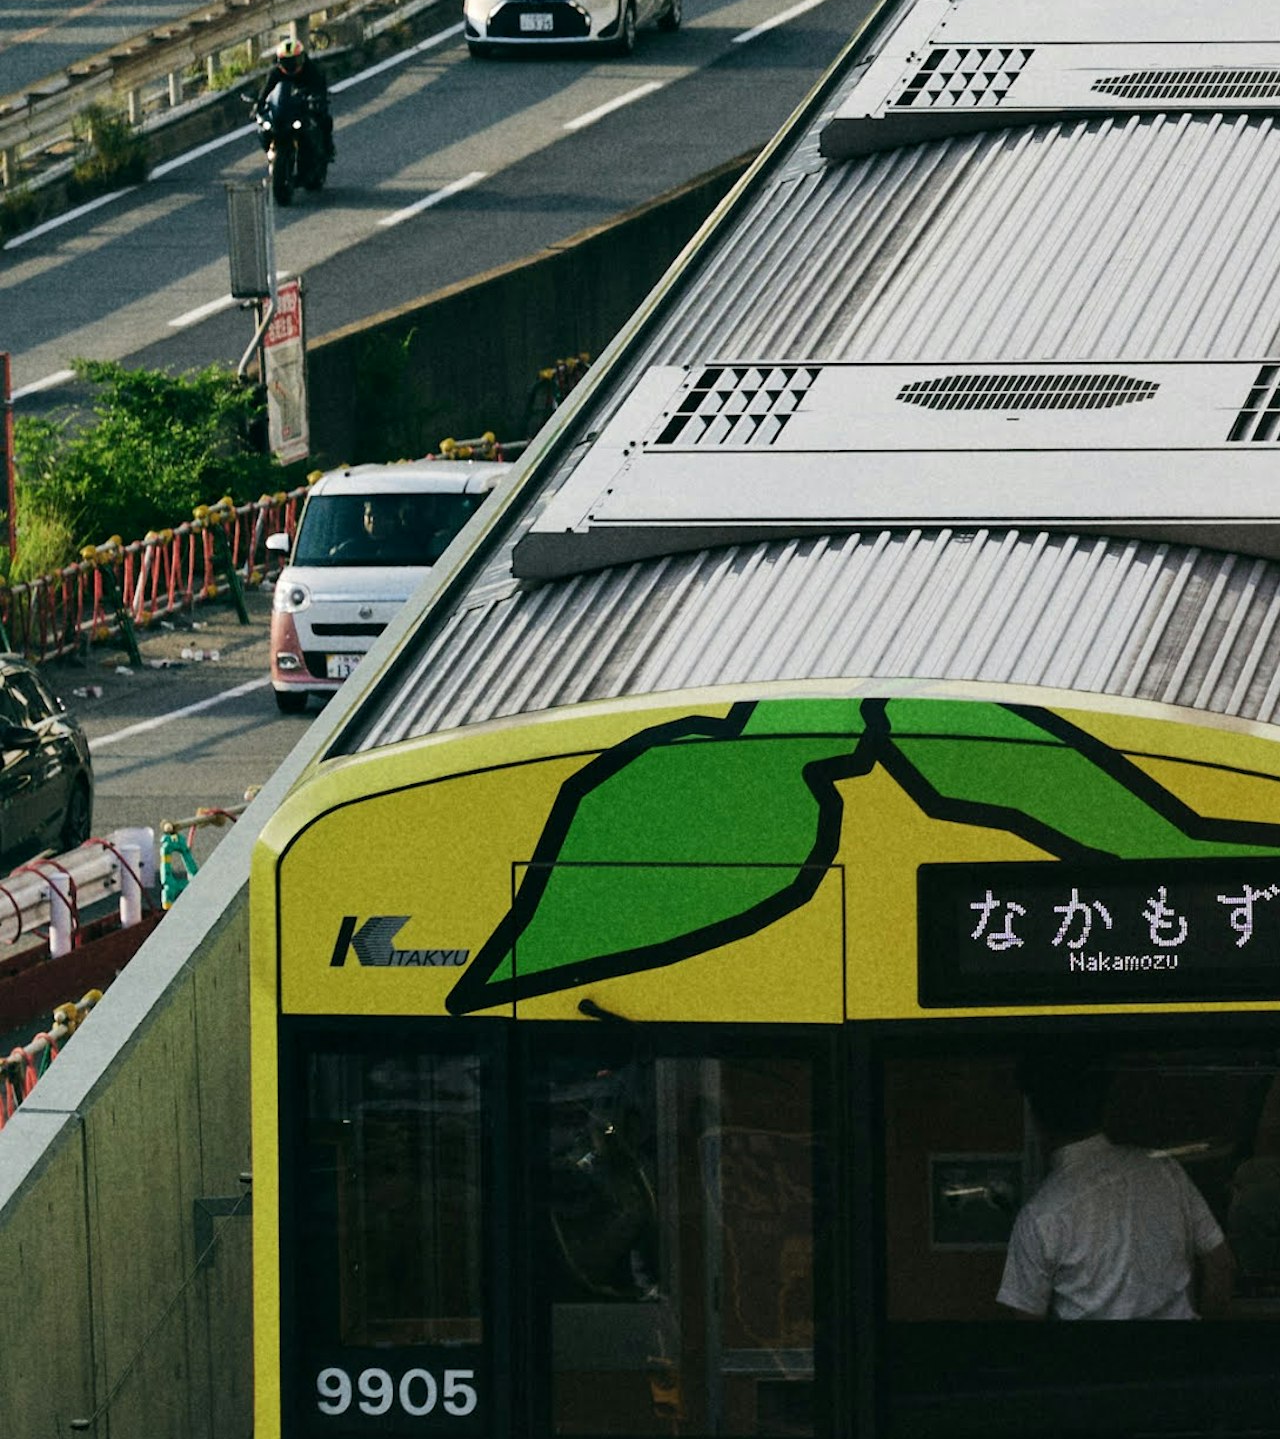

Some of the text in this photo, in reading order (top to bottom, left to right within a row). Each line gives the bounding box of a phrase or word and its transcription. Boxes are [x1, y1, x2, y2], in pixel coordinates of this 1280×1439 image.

[329, 916, 470, 967] KITAKYU
[970, 883, 1280, 951] なかもず
[1070, 951, 1179, 972] Nakamozu
[316, 1367, 478, 1417] 9905
